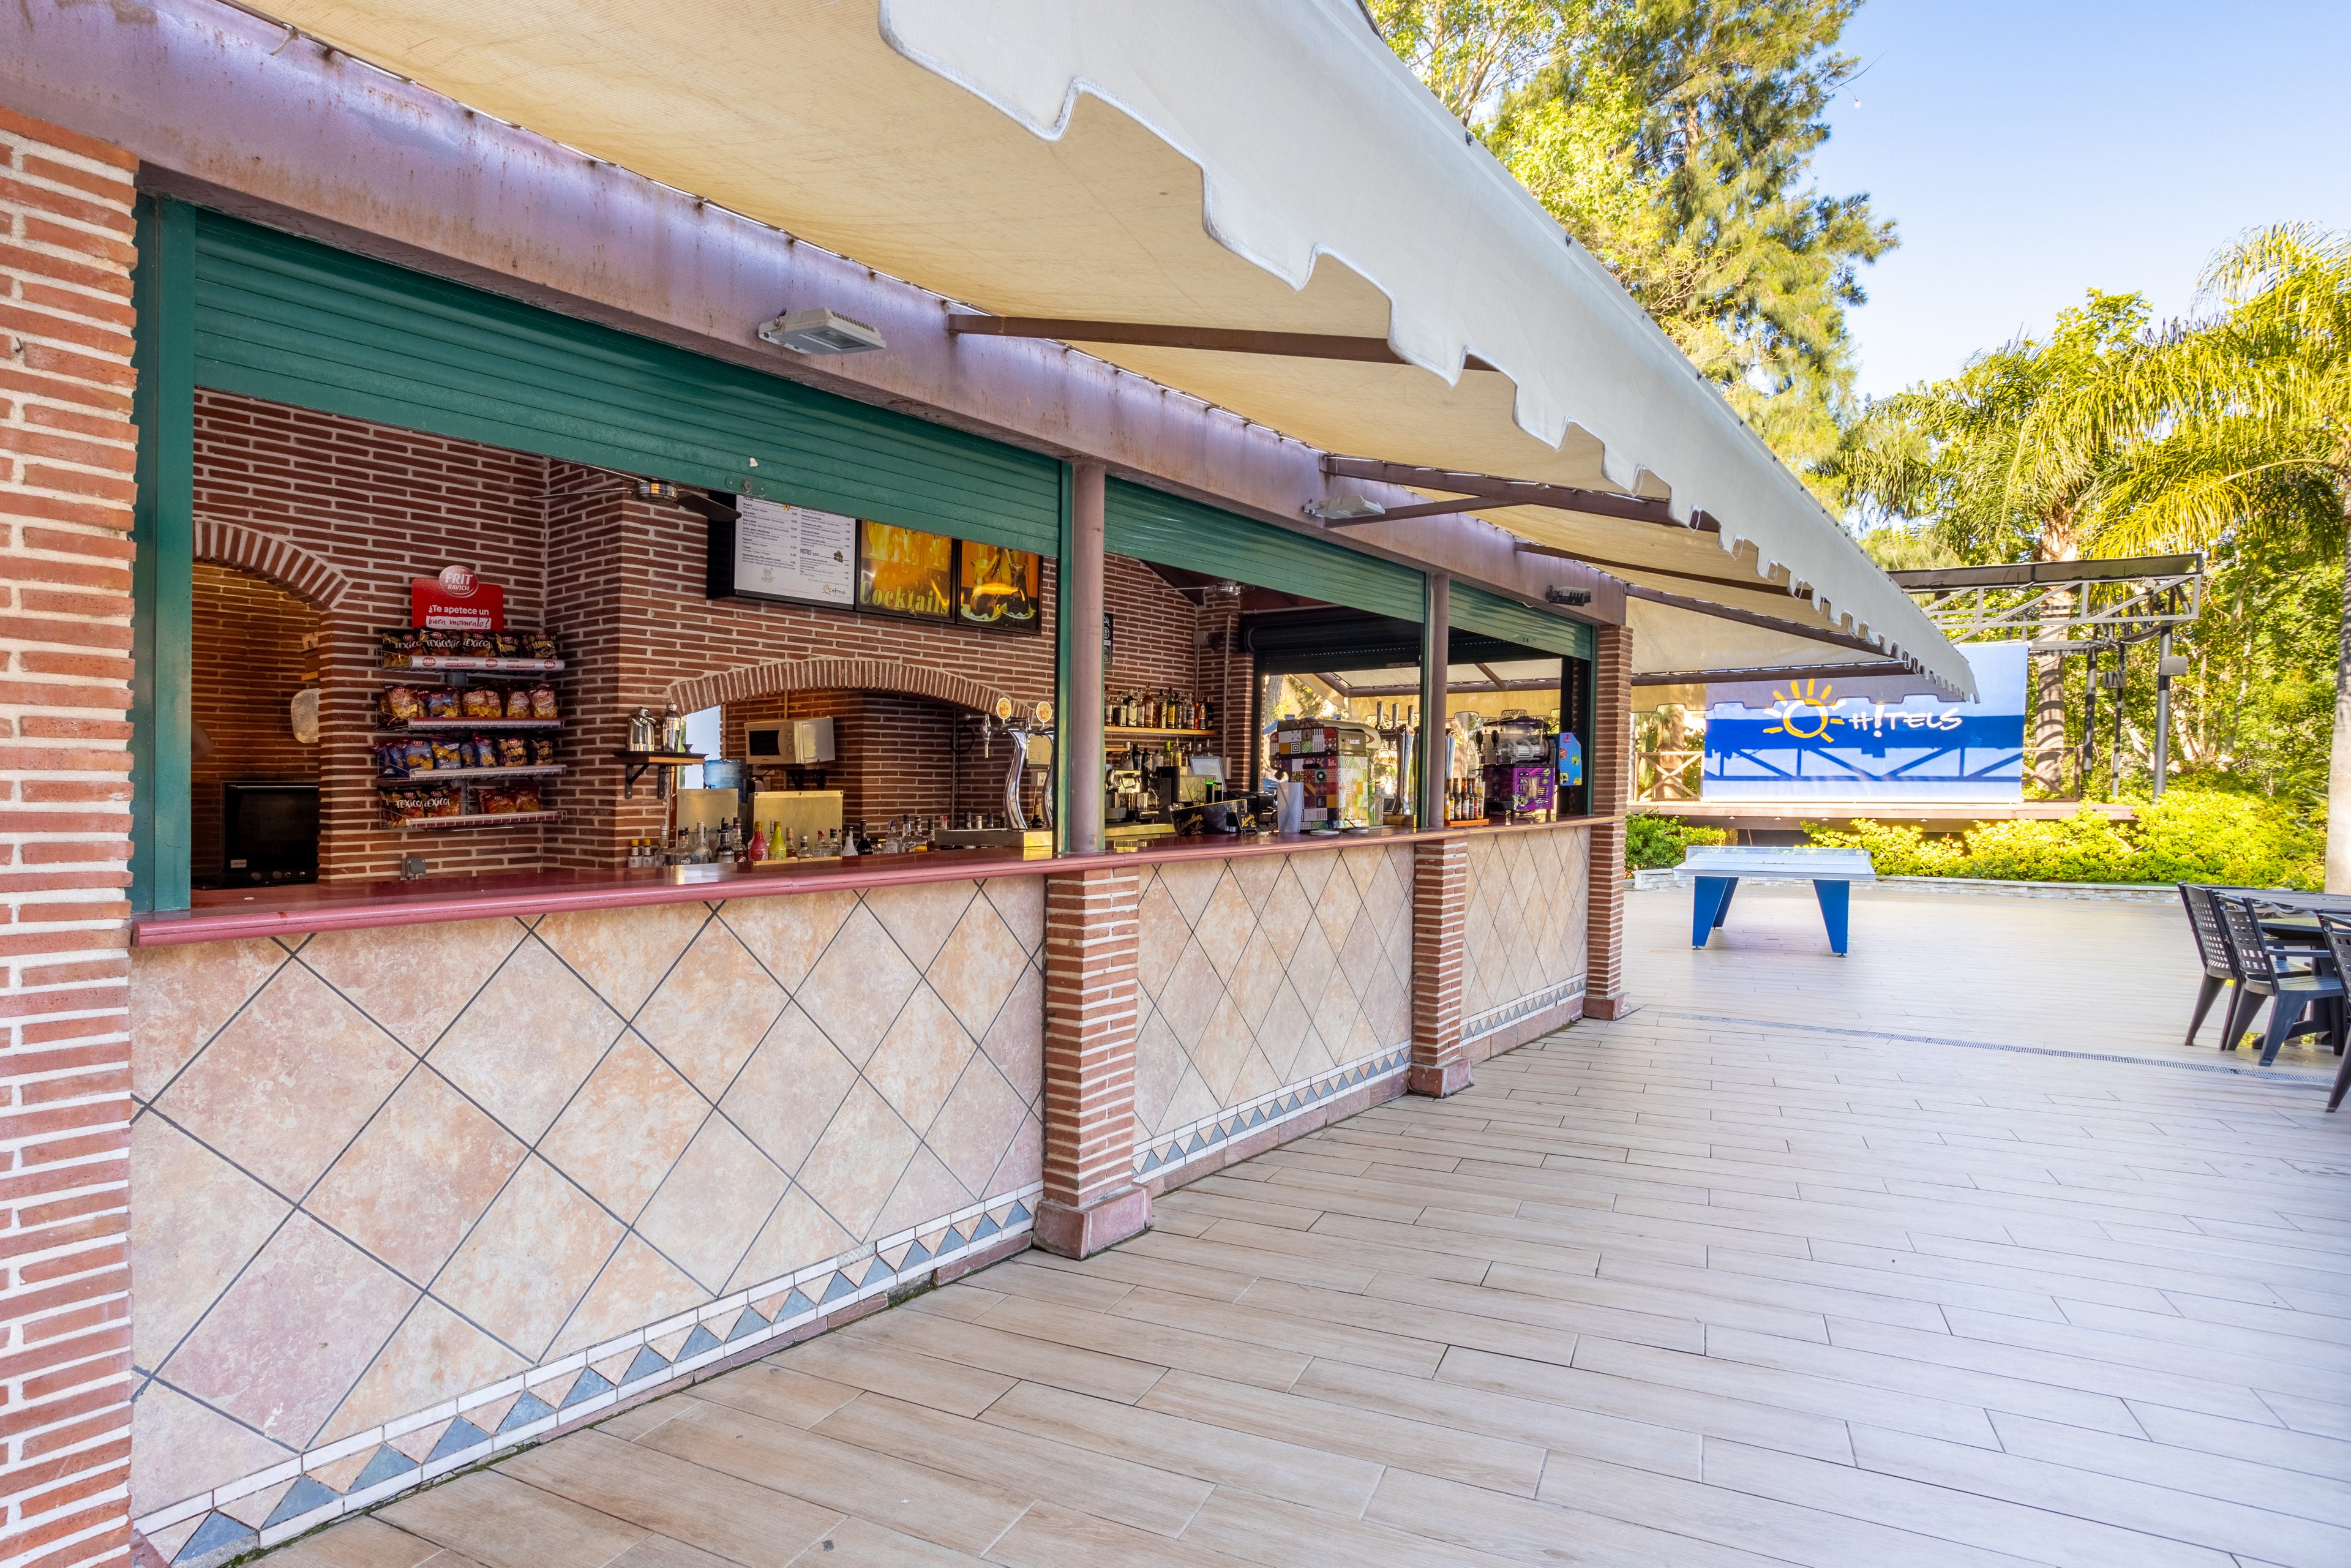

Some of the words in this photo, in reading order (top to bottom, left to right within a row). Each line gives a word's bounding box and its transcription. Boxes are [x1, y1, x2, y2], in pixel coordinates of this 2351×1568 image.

[444, 572, 473, 585] FRIT
[860, 580, 949, 614] Cocktails
[428, 604, 442, 613] ¿Te
[444, 606, 477, 615] apetece
[429, 616, 446, 625] buen
[449, 618, 490, 628] momento?
